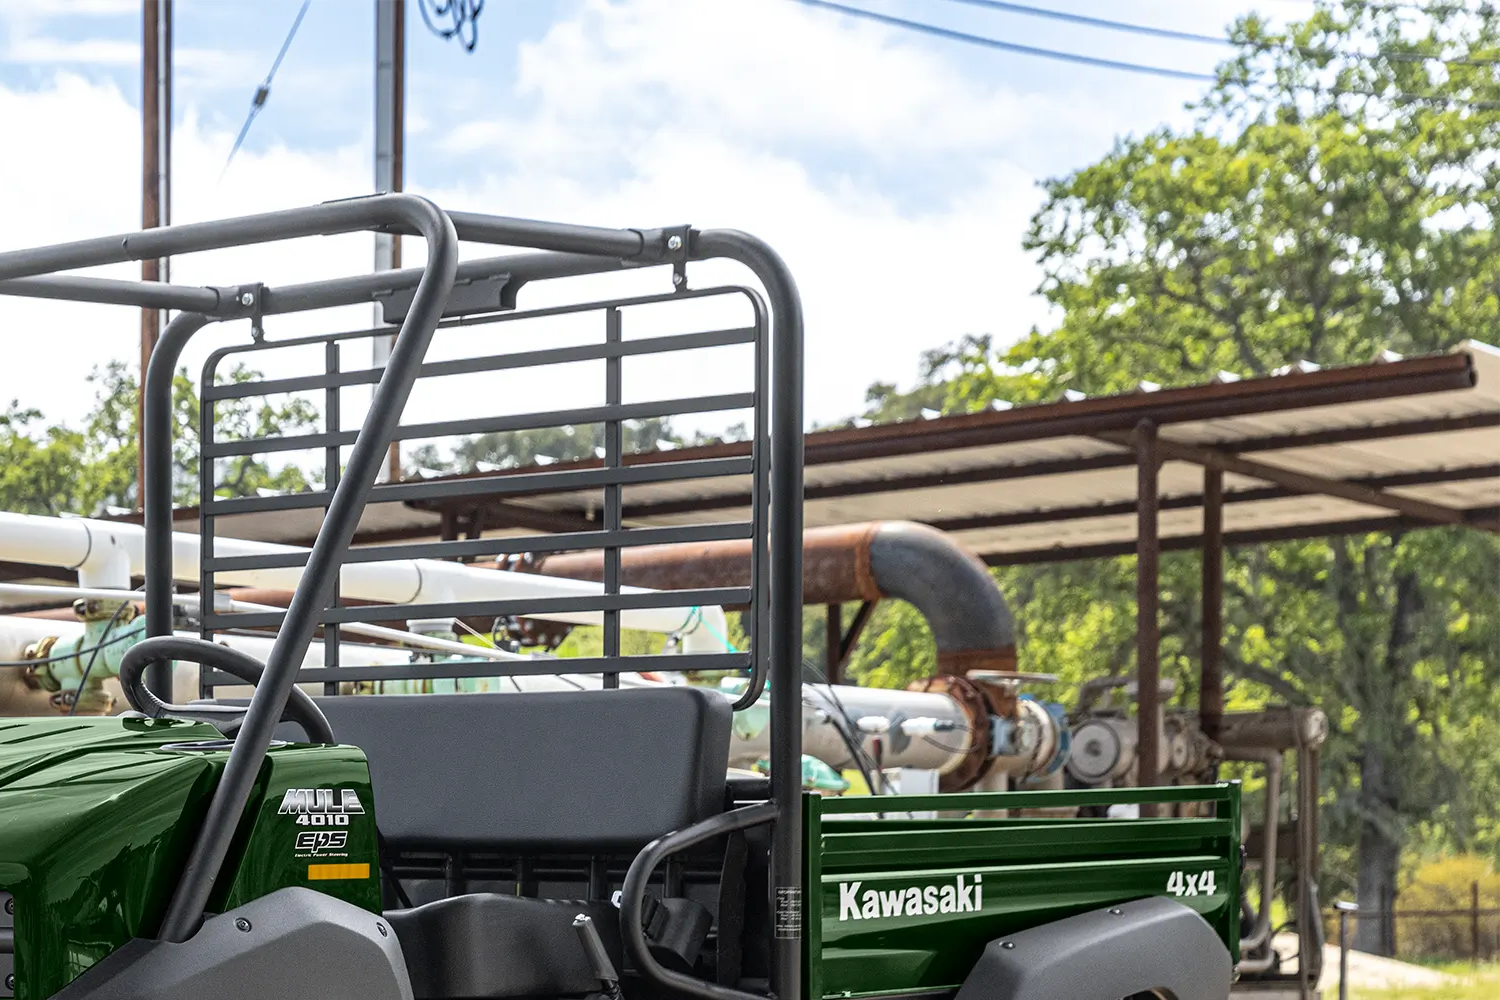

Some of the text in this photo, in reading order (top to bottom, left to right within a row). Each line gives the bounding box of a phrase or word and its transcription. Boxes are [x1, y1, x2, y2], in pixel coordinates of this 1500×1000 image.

[277, 788, 366, 814] MULE
[295, 814, 349, 826] 4010
[294, 830, 349, 853] EPS
[1166, 870, 1217, 897] 4x4
[838, 873, 984, 922] Kawasaki
